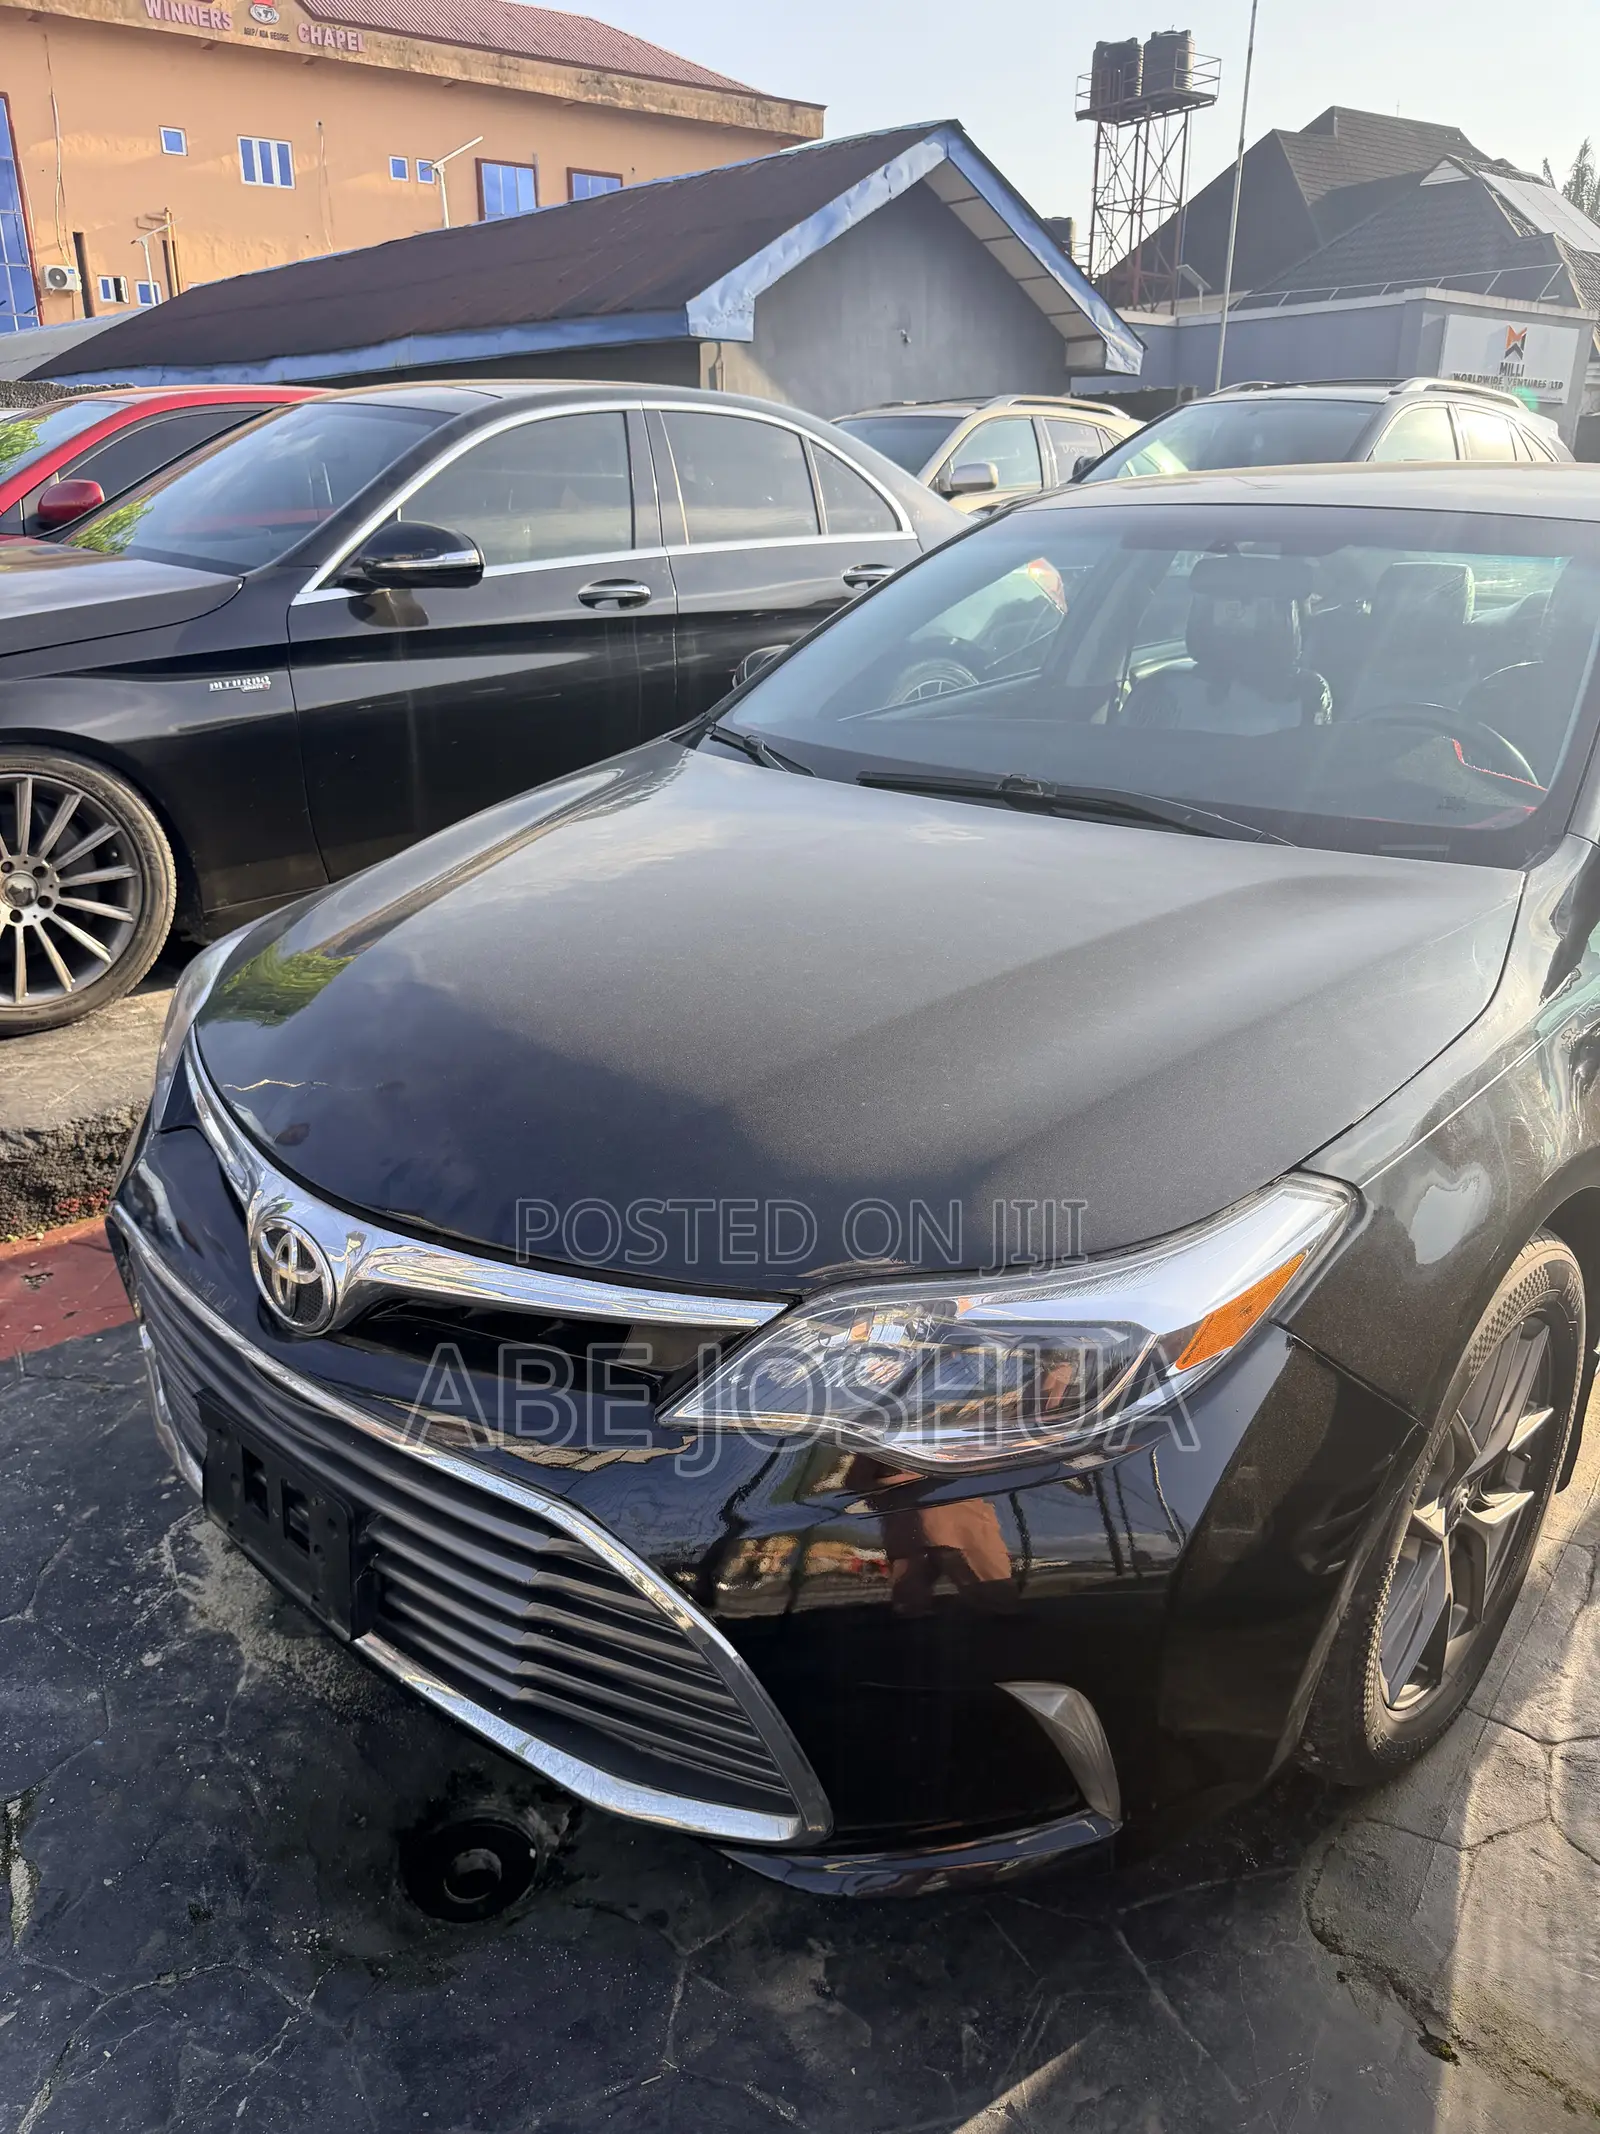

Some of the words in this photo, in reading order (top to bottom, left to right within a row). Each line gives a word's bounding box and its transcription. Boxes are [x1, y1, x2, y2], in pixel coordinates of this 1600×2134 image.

[145, 0, 233, 31] WINNERS
[297, 22, 366, 53] CHAPEL
[1453, 372, 1503, 385] WORLDWIDE
[1508, 377, 1547, 389] VENTURES
[1550, 381, 1564, 390] LTD
[1499, 361, 1525, 377] MILLI
